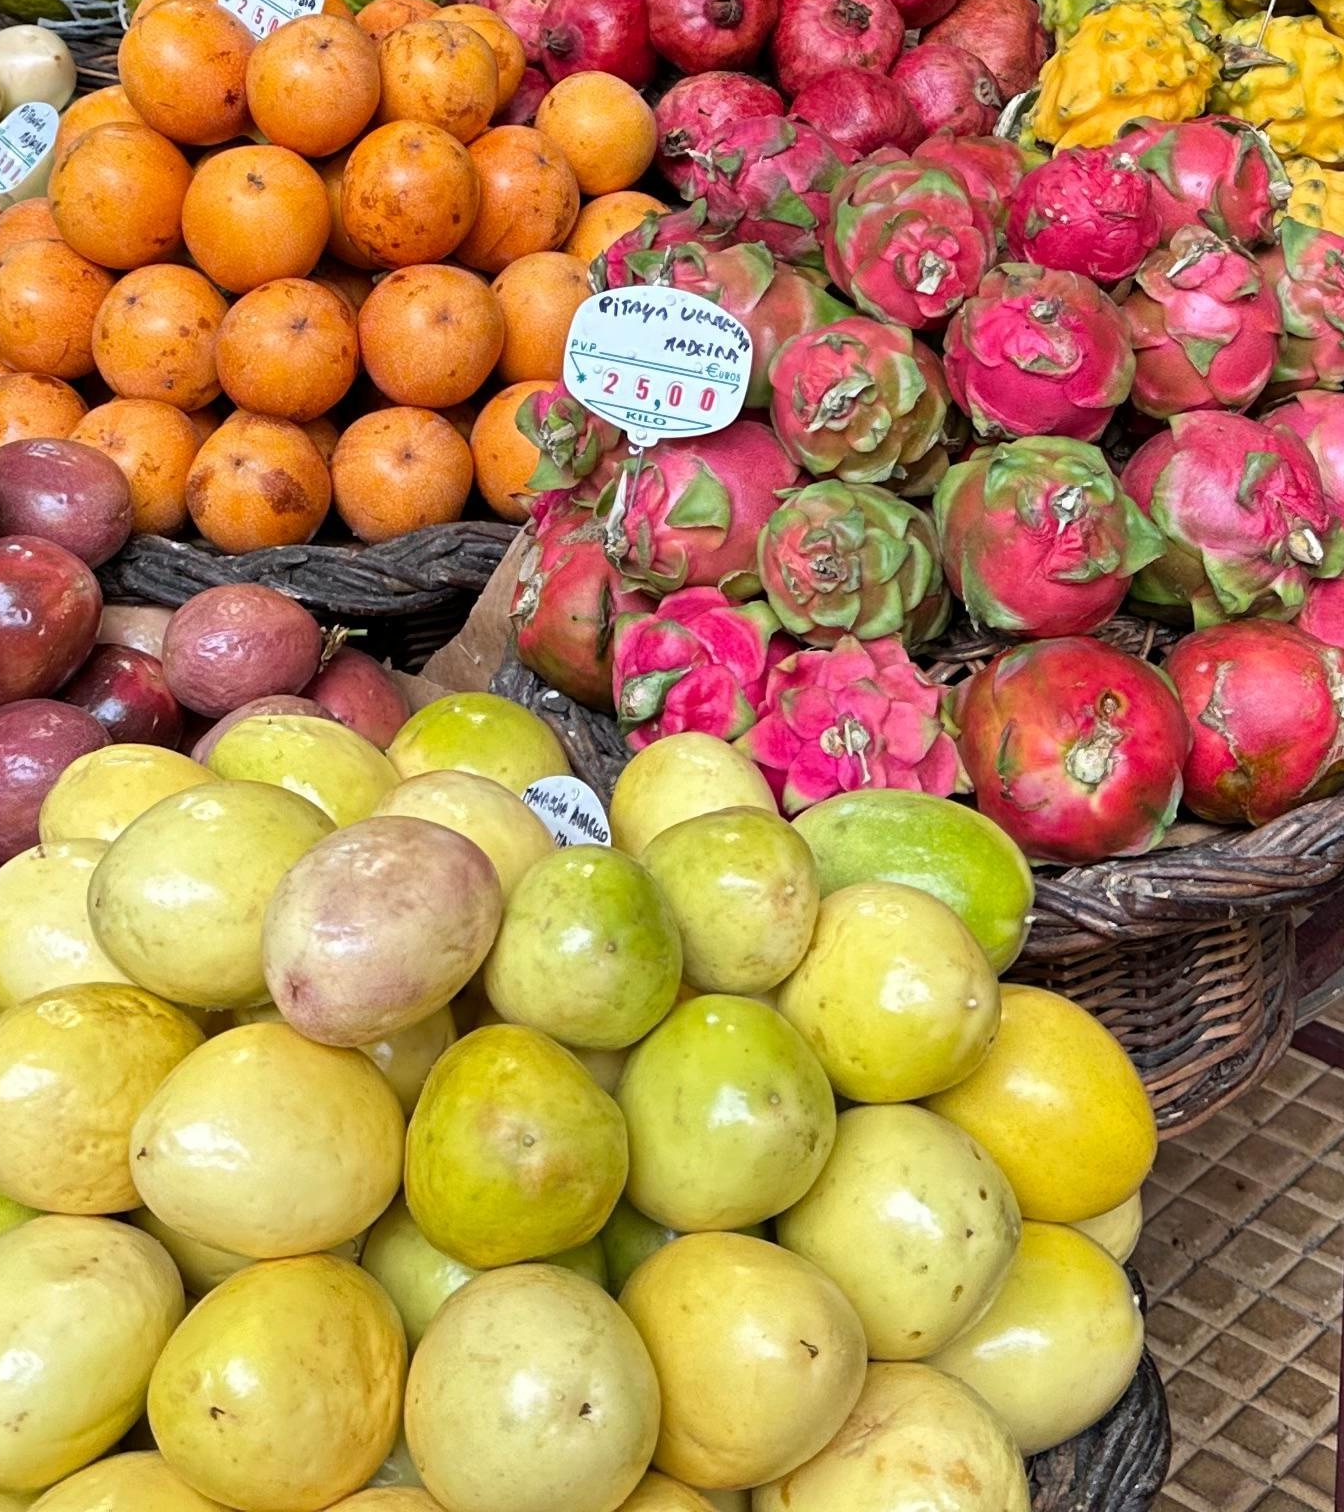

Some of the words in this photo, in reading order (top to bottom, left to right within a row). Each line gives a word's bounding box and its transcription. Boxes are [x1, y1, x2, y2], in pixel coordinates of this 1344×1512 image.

[704, 361, 742, 384] €UROS
[602, 372, 717, 413] 25,00
[625, 410, 668, 427] KILO
